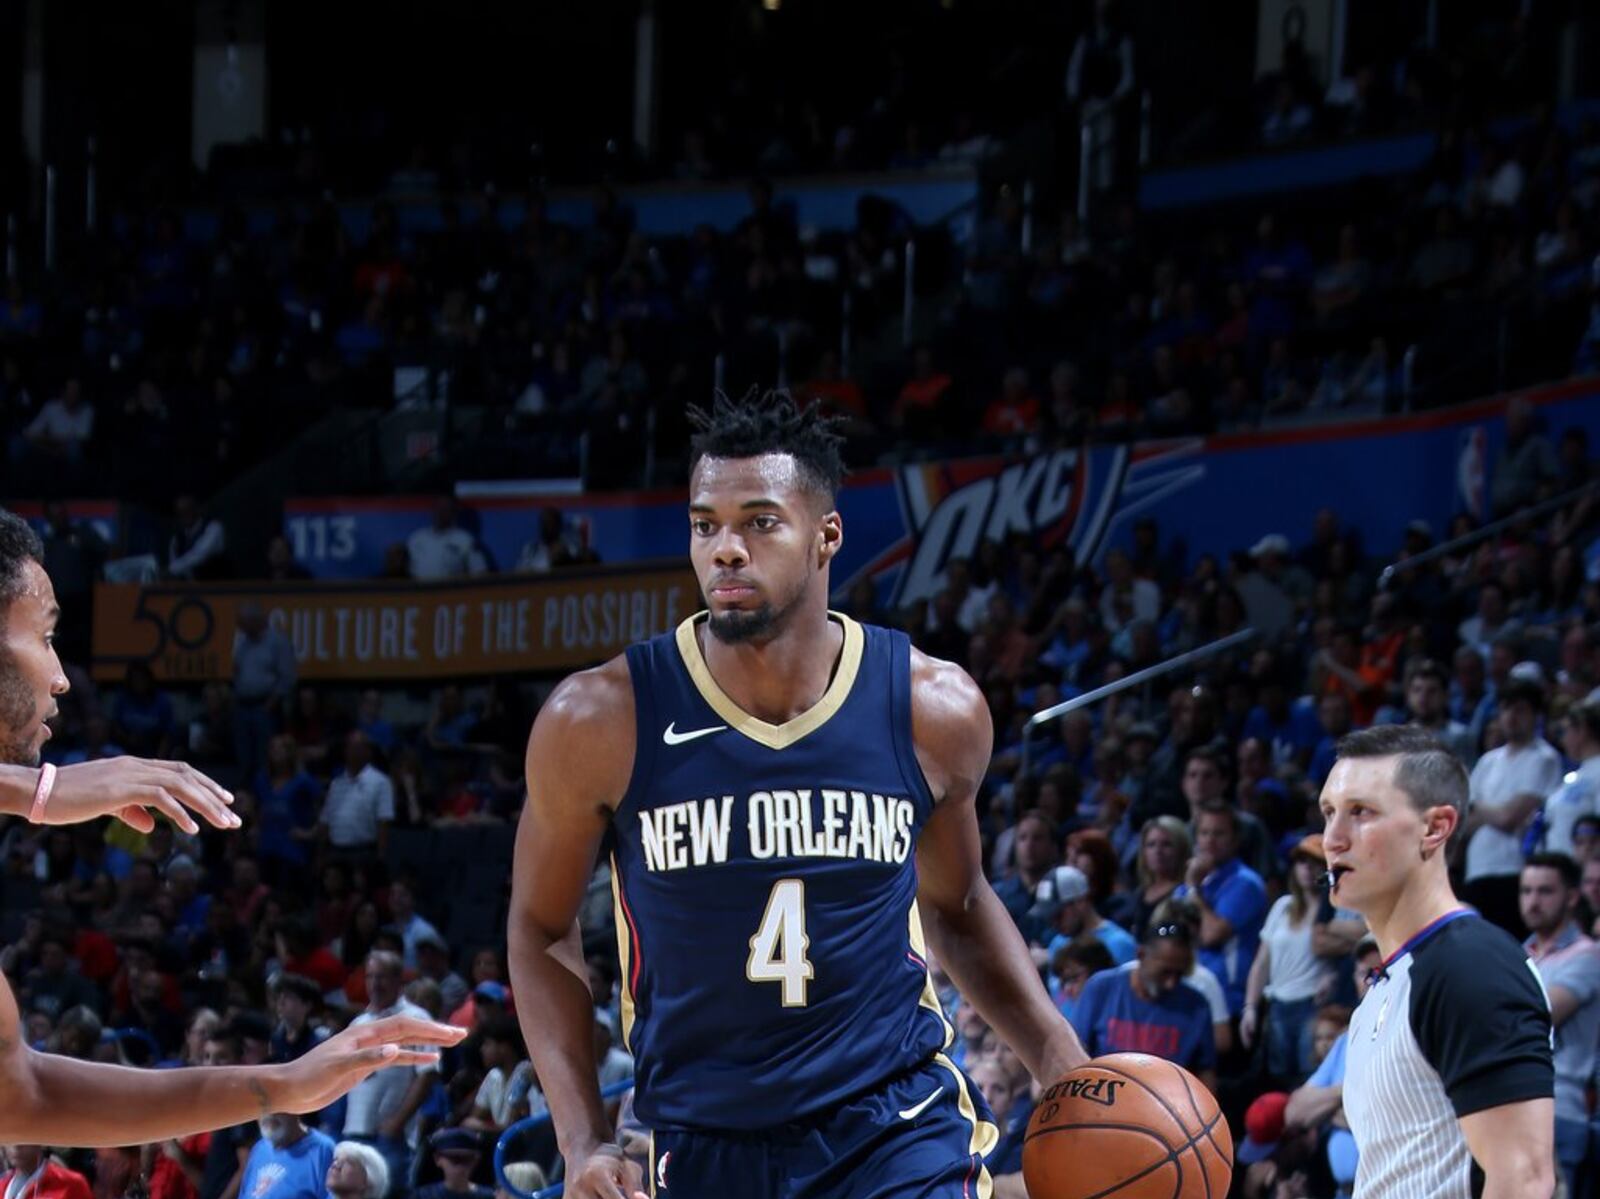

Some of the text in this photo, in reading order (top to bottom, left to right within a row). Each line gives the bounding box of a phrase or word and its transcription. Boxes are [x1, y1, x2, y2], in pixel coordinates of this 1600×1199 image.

[287, 516, 358, 561] 113
[899, 449, 1078, 610] OKC
[434, 603, 470, 660] OF
[481, 598, 531, 655] THE
[543, 585, 681, 648] POSSIBLE
[637, 788, 915, 873] NEW ORLEANS
[746, 878, 815, 1009] 4
[1041, 1078, 1126, 1106] SPALD
